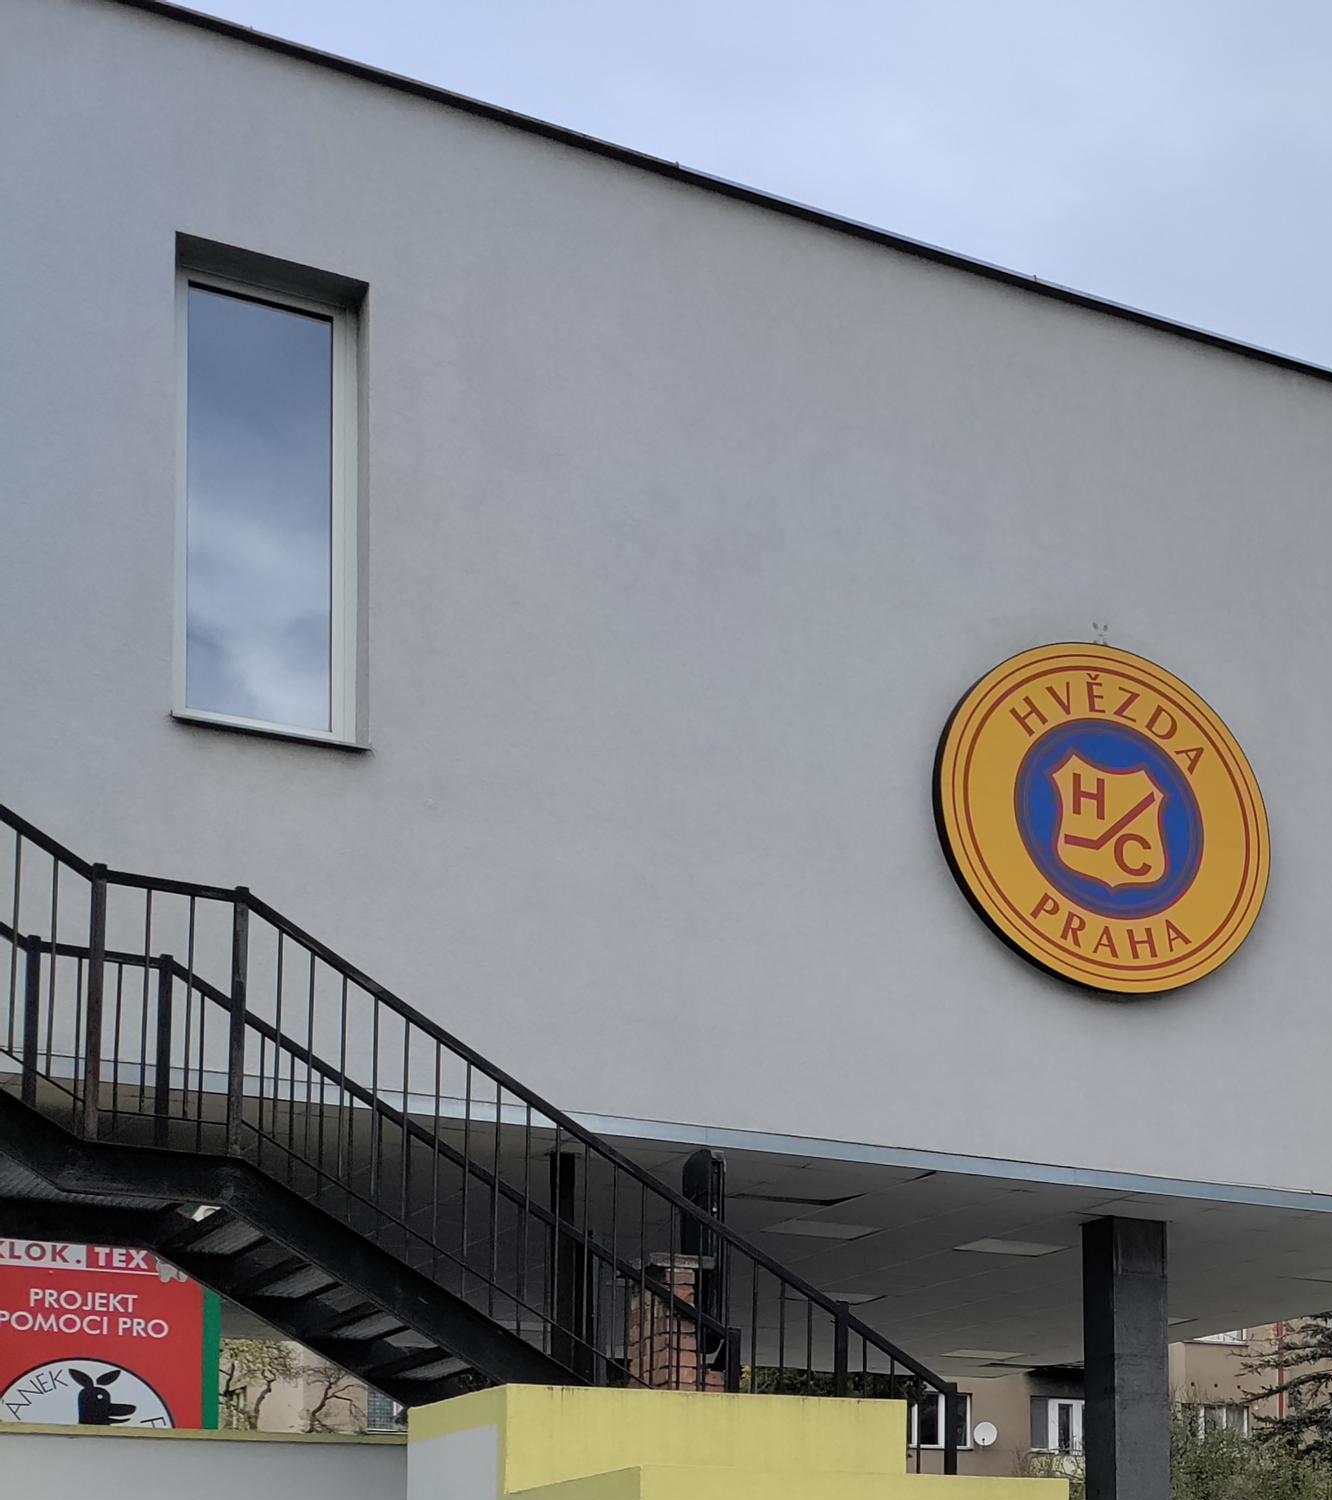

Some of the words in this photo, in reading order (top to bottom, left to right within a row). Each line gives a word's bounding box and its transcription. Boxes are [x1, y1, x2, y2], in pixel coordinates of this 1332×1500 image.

[1009, 674, 1204, 775] HVĚZDA
[1030, 892, 1192, 960] PRAHA
[94, 1246, 149, 1270] TEX
[29, 1288, 138, 1313] PROJEKT
[0, 1309, 108, 1335] POMOCI
[118, 1317, 169, 1339] PRO
[0, 1368, 69, 1421] ÁNEK
